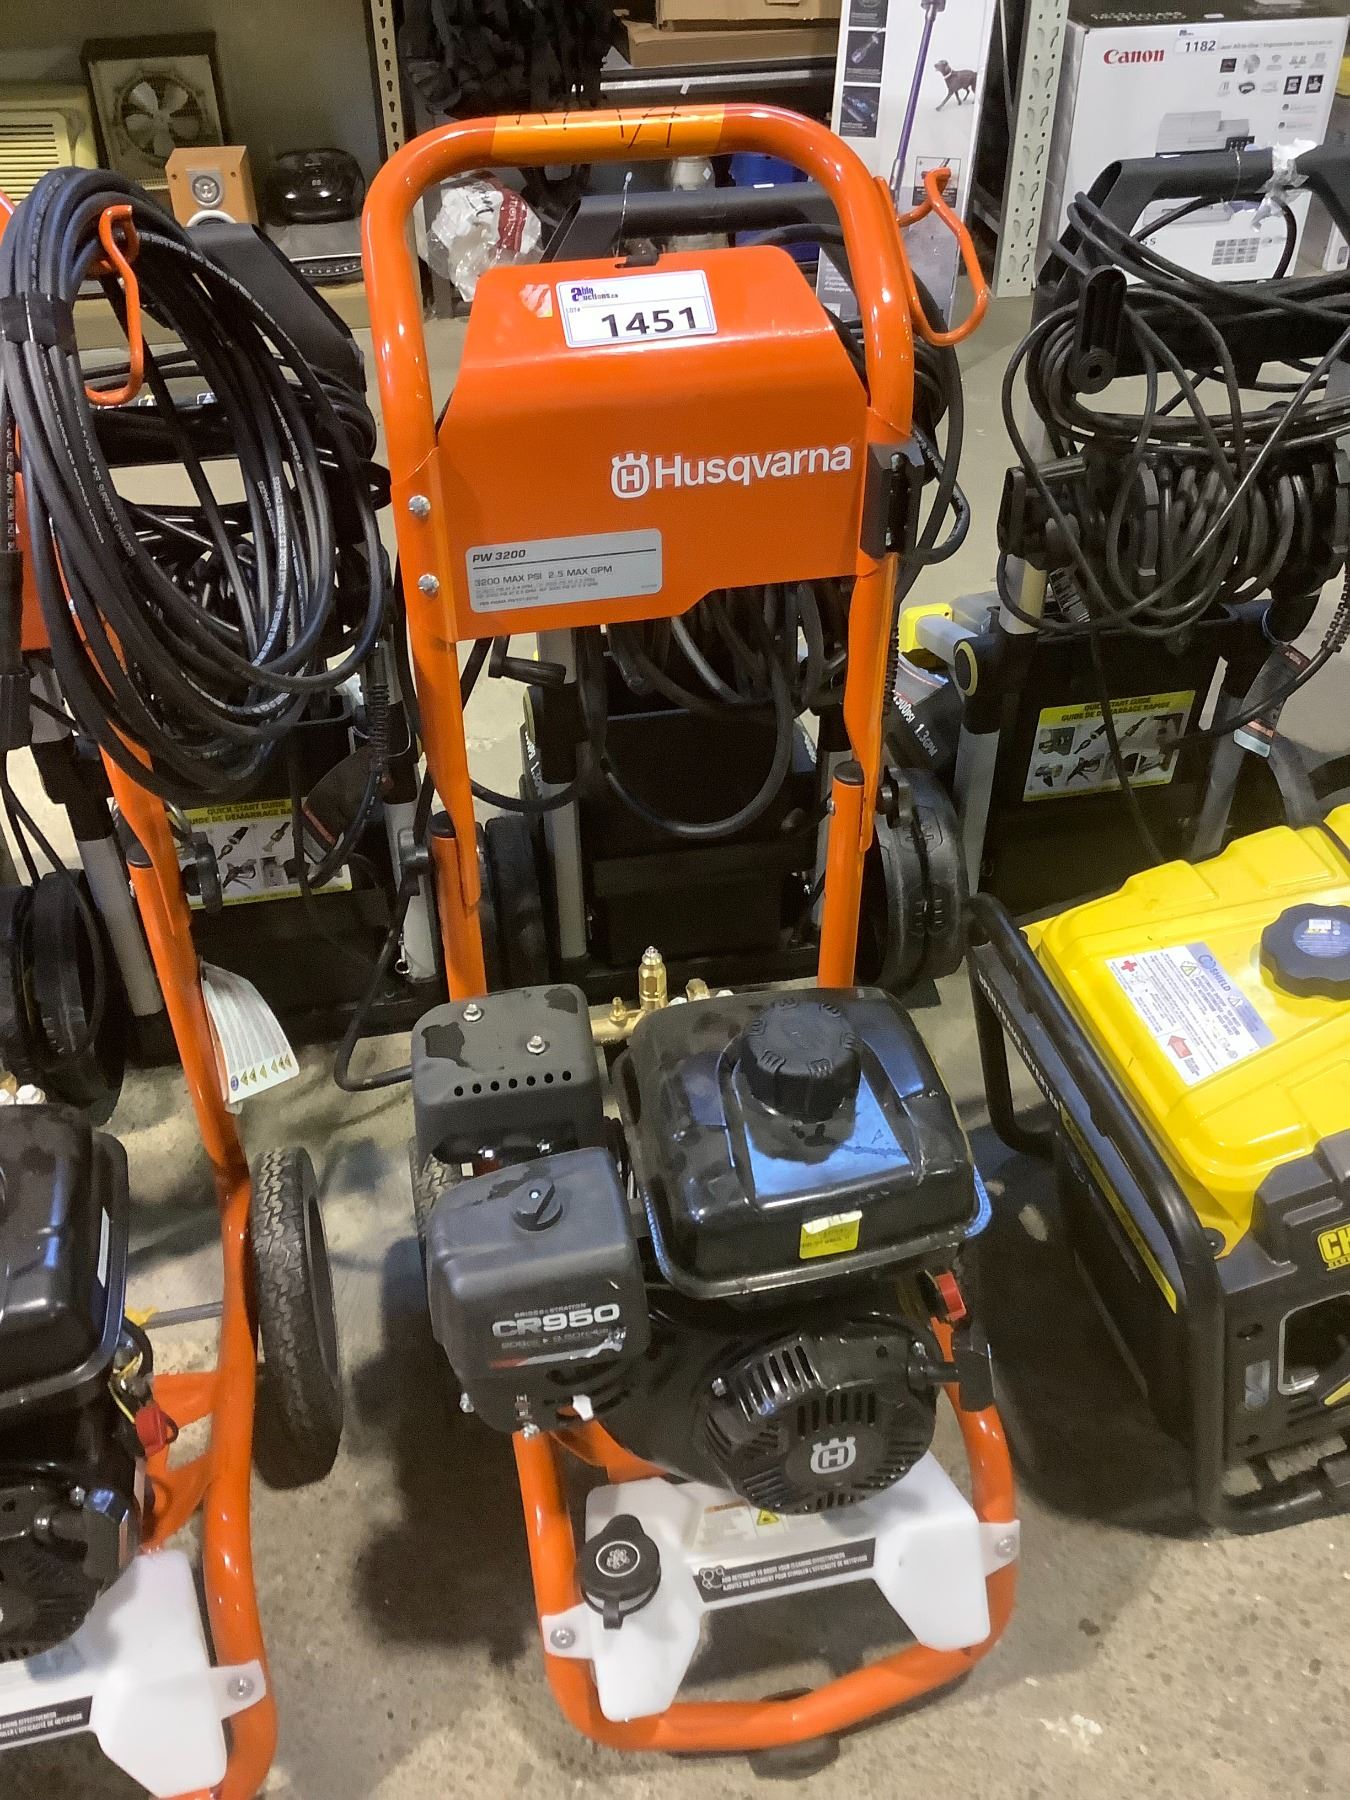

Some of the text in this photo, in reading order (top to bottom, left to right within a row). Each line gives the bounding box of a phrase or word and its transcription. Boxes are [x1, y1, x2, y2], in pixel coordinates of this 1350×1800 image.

[1103, 49, 1165, 65] Canon
[1185, 40, 1216, 52] 1182
[601, 307, 696, 337] 1451
[655, 445, 851, 489] Husqvarna
[472, 550, 526, 563] PW 3200
[474, 577, 500, 587] 3200
[502, 574, 524, 584] MAX
[527, 573, 542, 581] PSI
[567, 567, 589, 576] MAX
[590, 565, 612, 574] GPM
[492, 1303, 620, 1337] CR950
